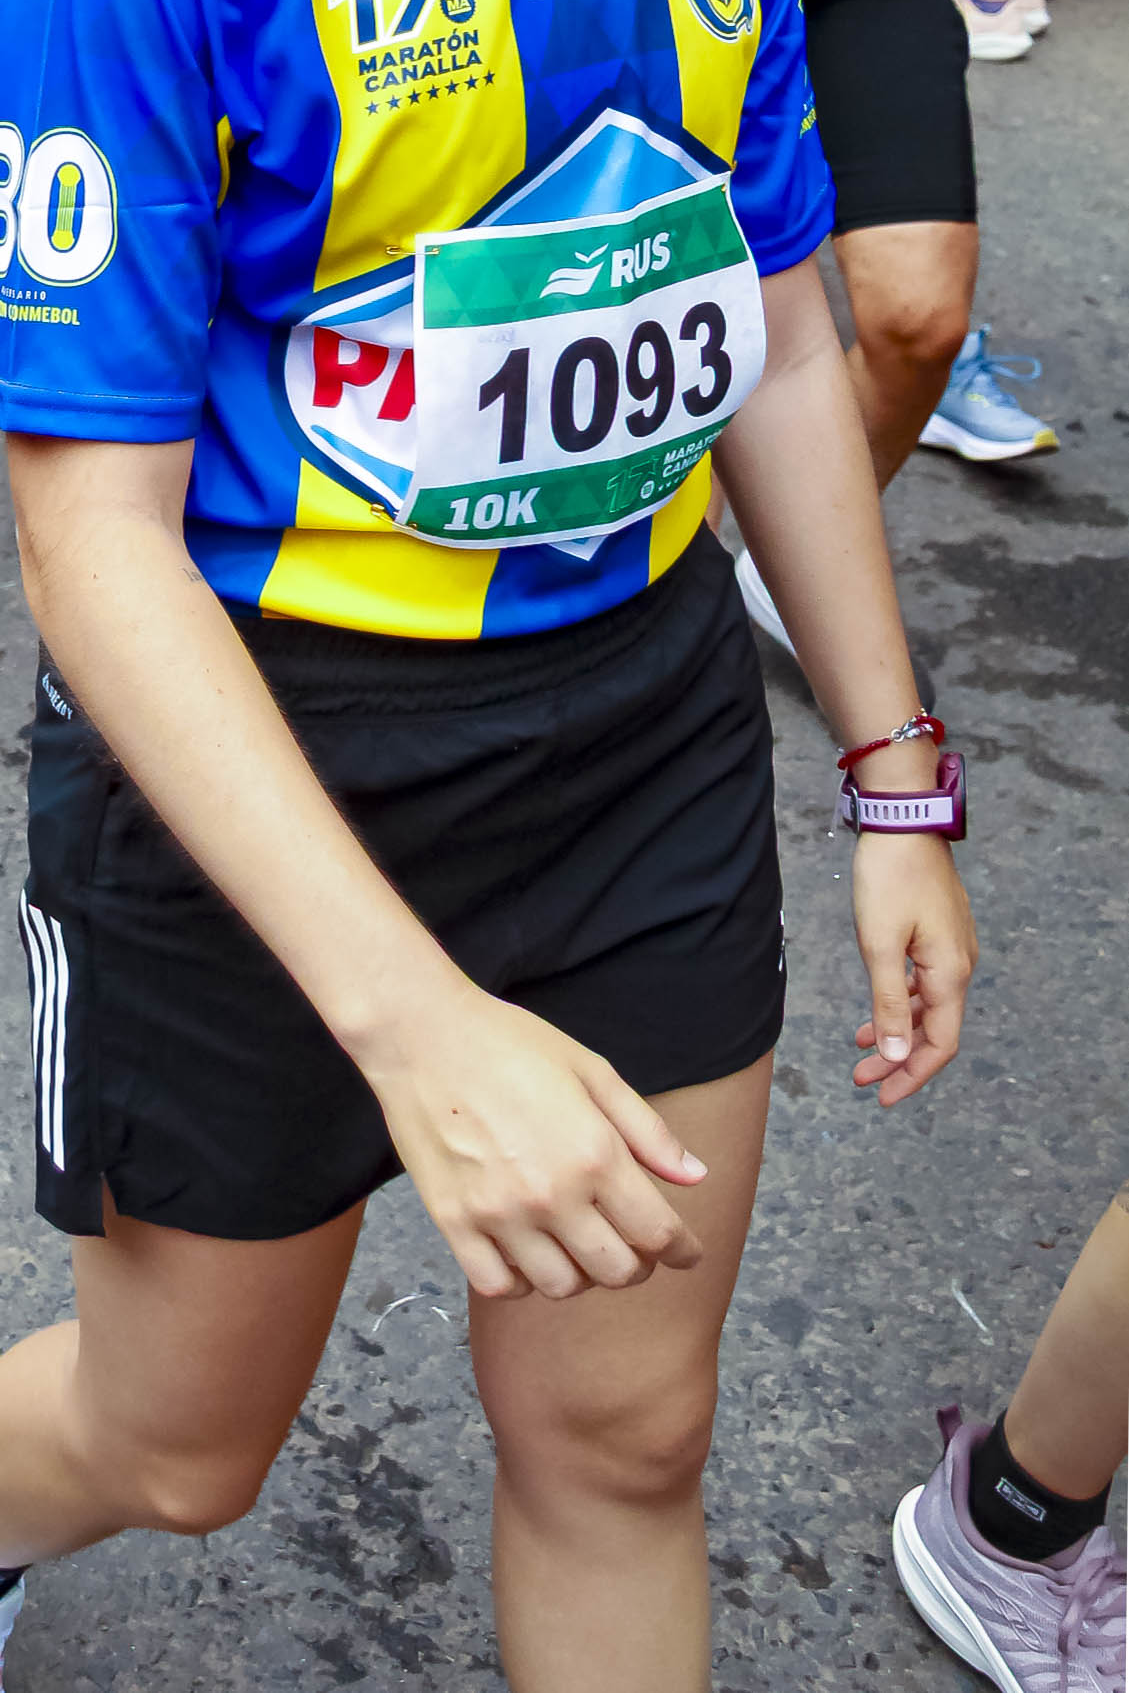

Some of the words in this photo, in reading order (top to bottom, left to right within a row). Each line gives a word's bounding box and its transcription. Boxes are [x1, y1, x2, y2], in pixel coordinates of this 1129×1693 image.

[358, 29, 479, 76] MARATÓN
[364, 50, 483, 93] CANALLA
[611, 232, 672, 287] RUS
[479, 301, 733, 465] 1093
[443, 487, 542, 531] 10K
